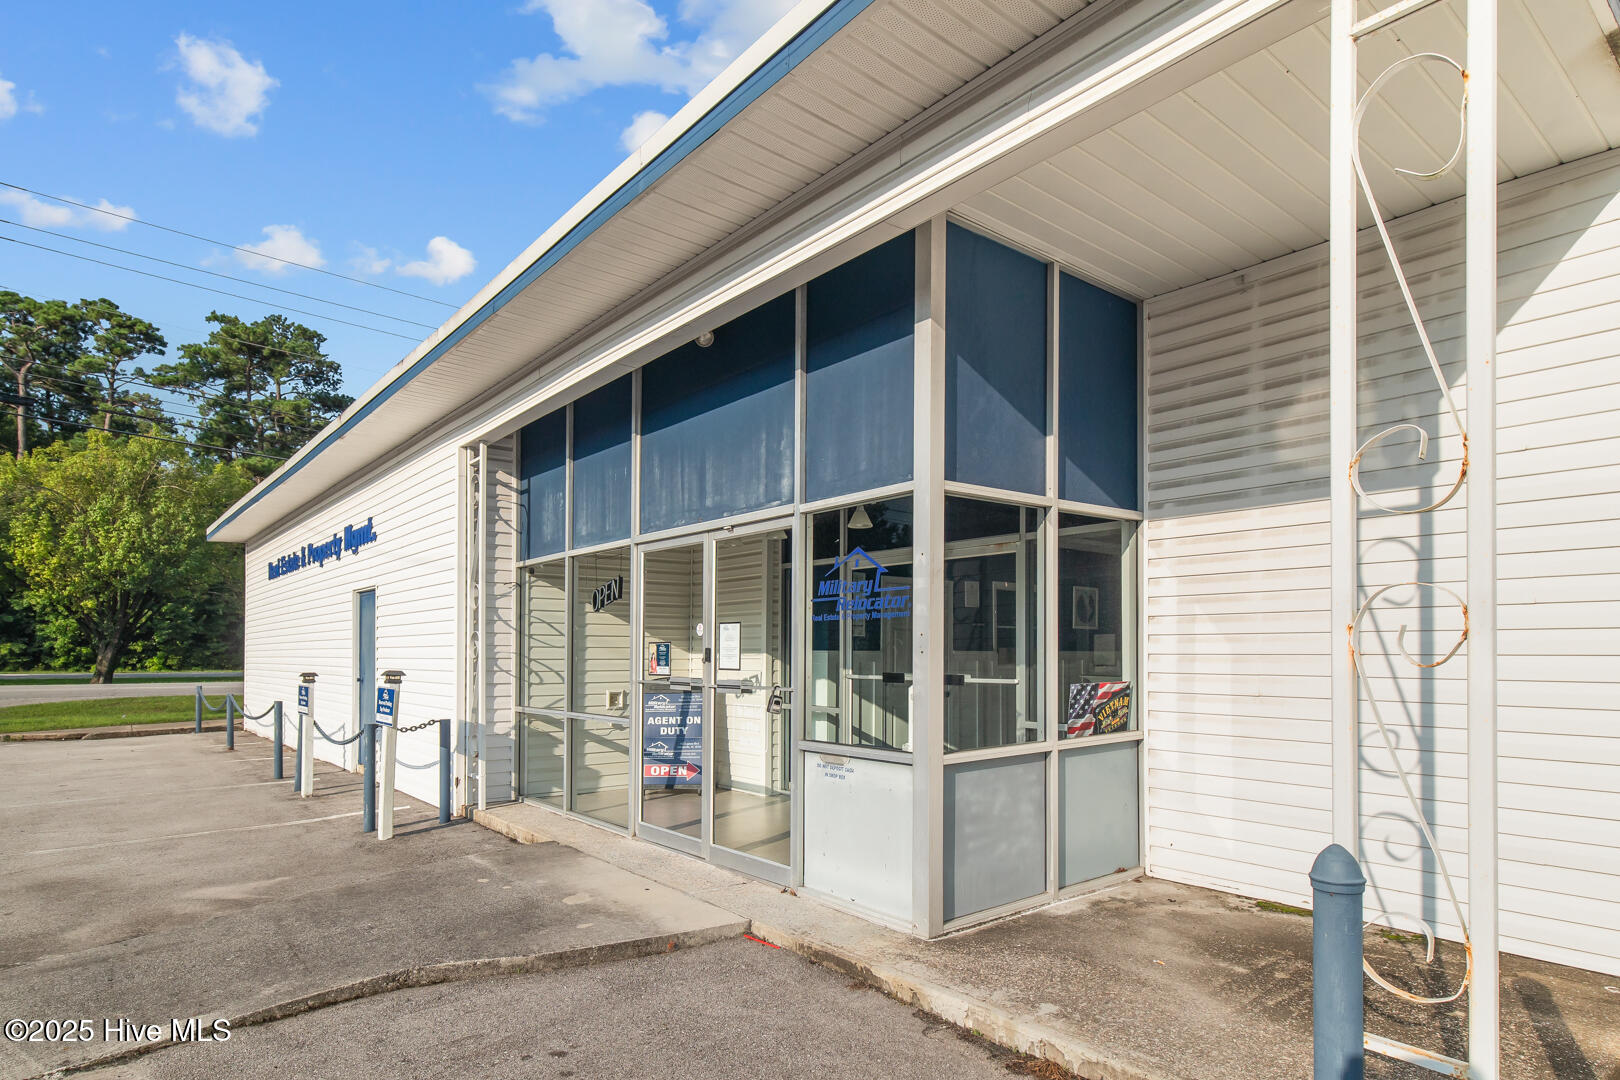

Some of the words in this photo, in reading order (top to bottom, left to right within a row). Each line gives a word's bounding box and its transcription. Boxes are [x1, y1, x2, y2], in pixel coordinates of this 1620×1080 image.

[307, 533, 343, 568] Property
[592, 578, 620, 612] OPEN
[818, 579, 874, 597] Military
[835, 594, 910, 611] Relocator
[1098, 696, 1129, 721] VIETNAM
[647, 716, 682, 726] AGENT
[686, 716, 701, 725] ON
[660, 726, 689, 736] DUTY
[650, 766, 688, 776] OPEN
